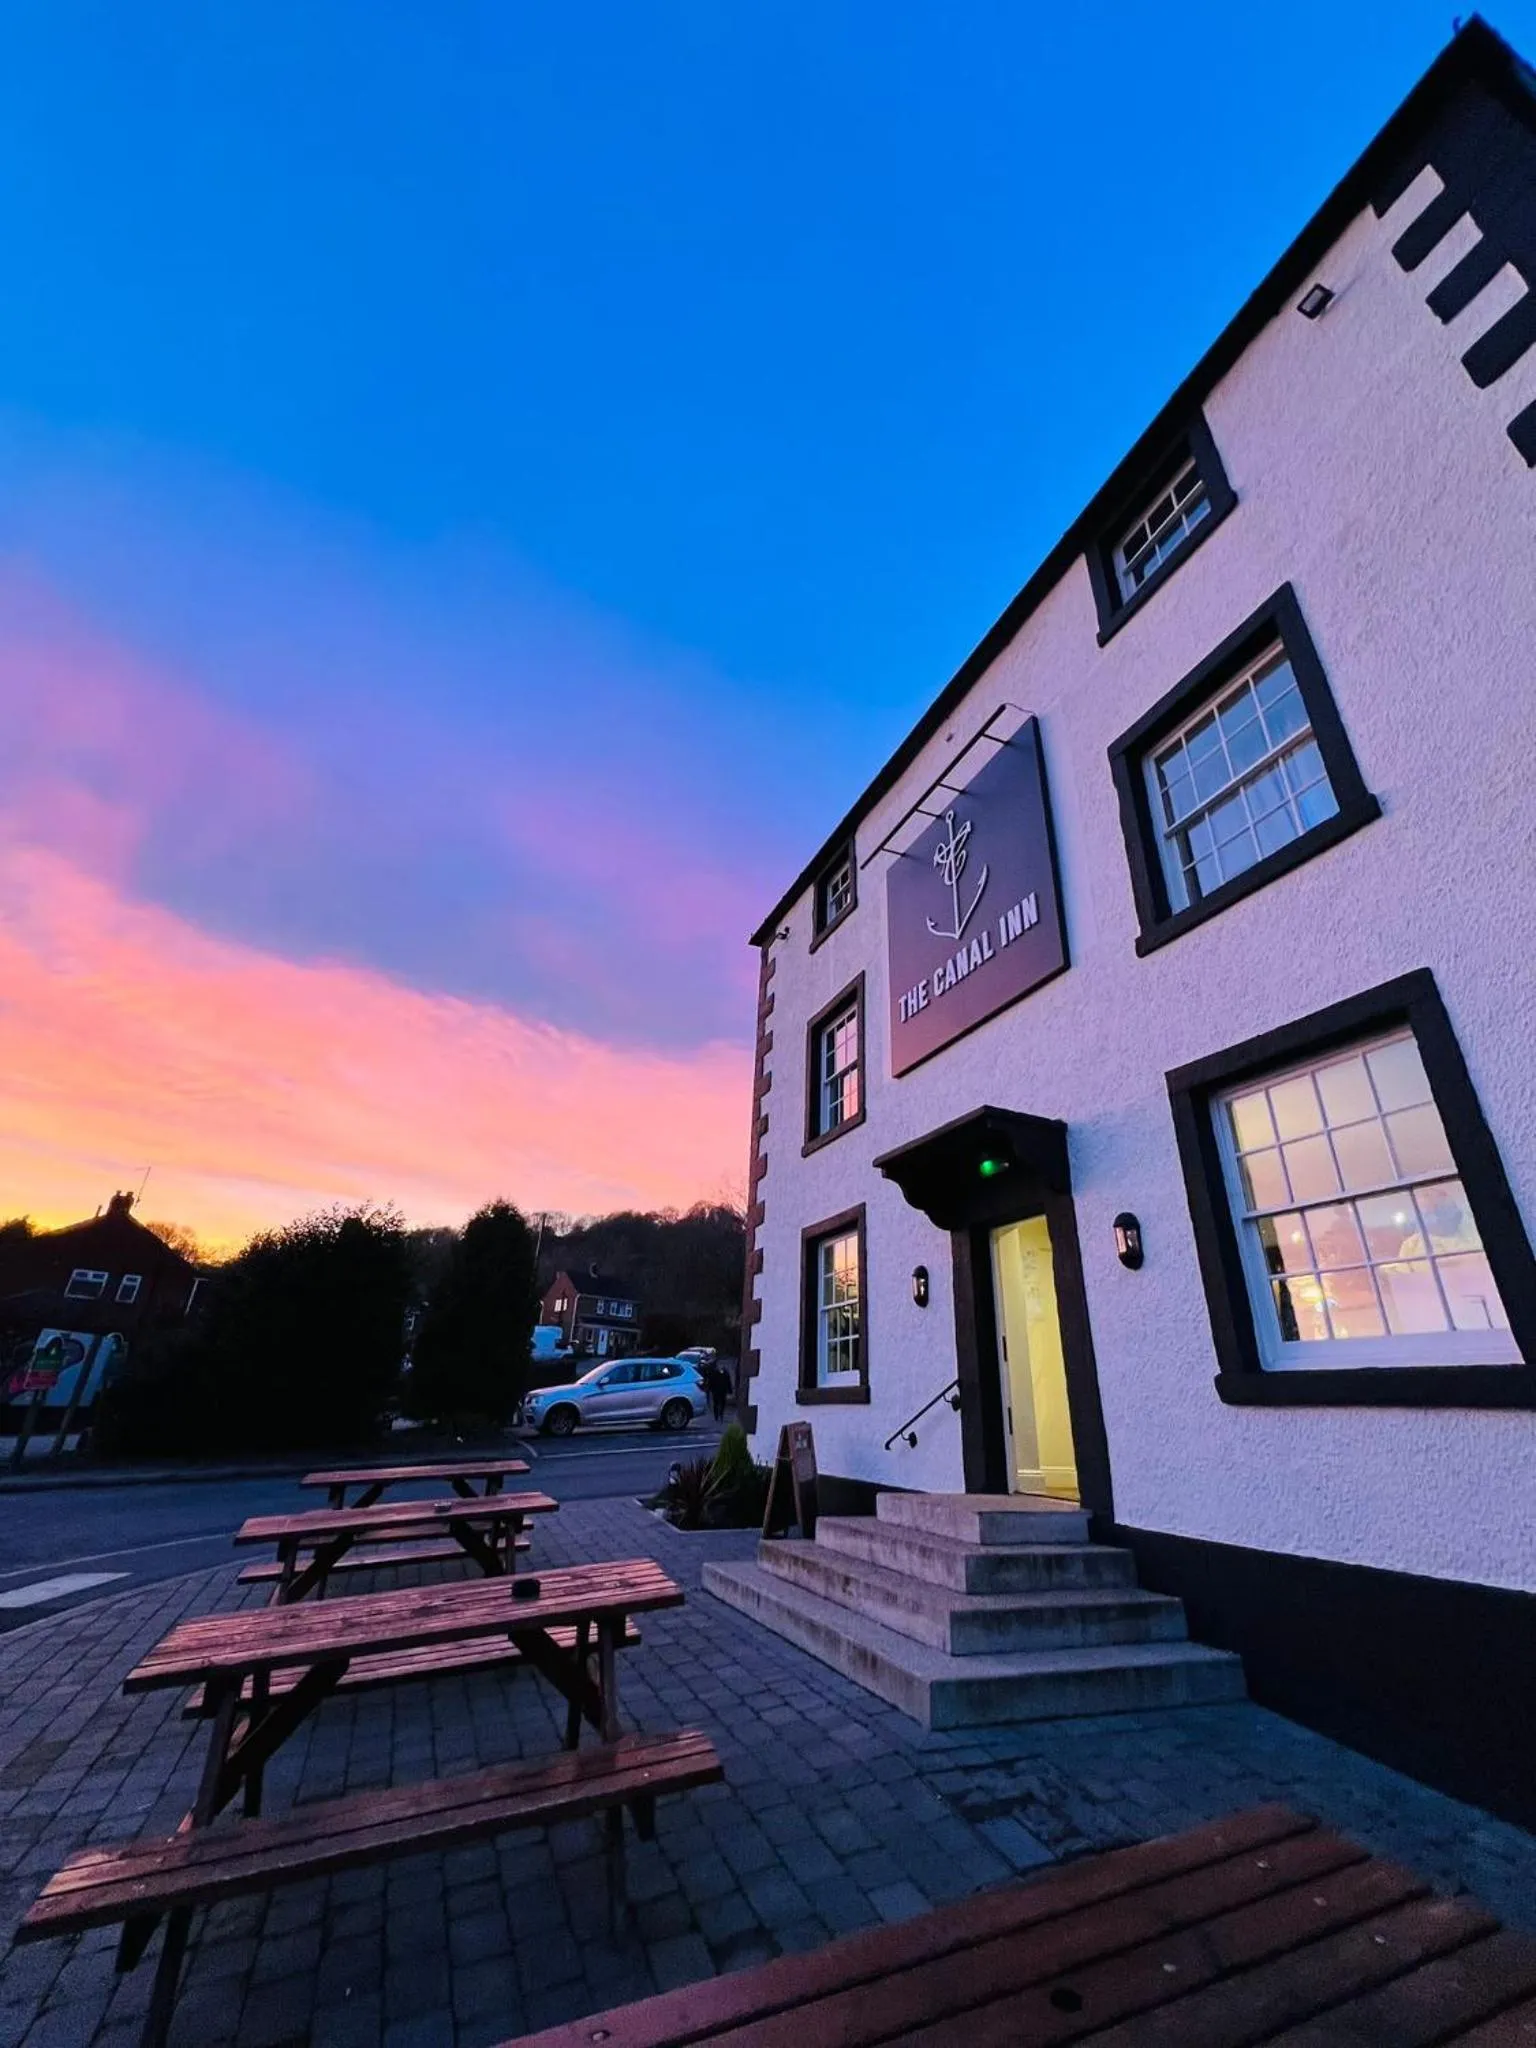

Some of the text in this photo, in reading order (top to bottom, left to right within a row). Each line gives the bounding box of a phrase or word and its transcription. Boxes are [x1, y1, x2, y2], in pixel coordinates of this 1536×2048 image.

[898, 892, 1038, 1022] THE CANAL INN
